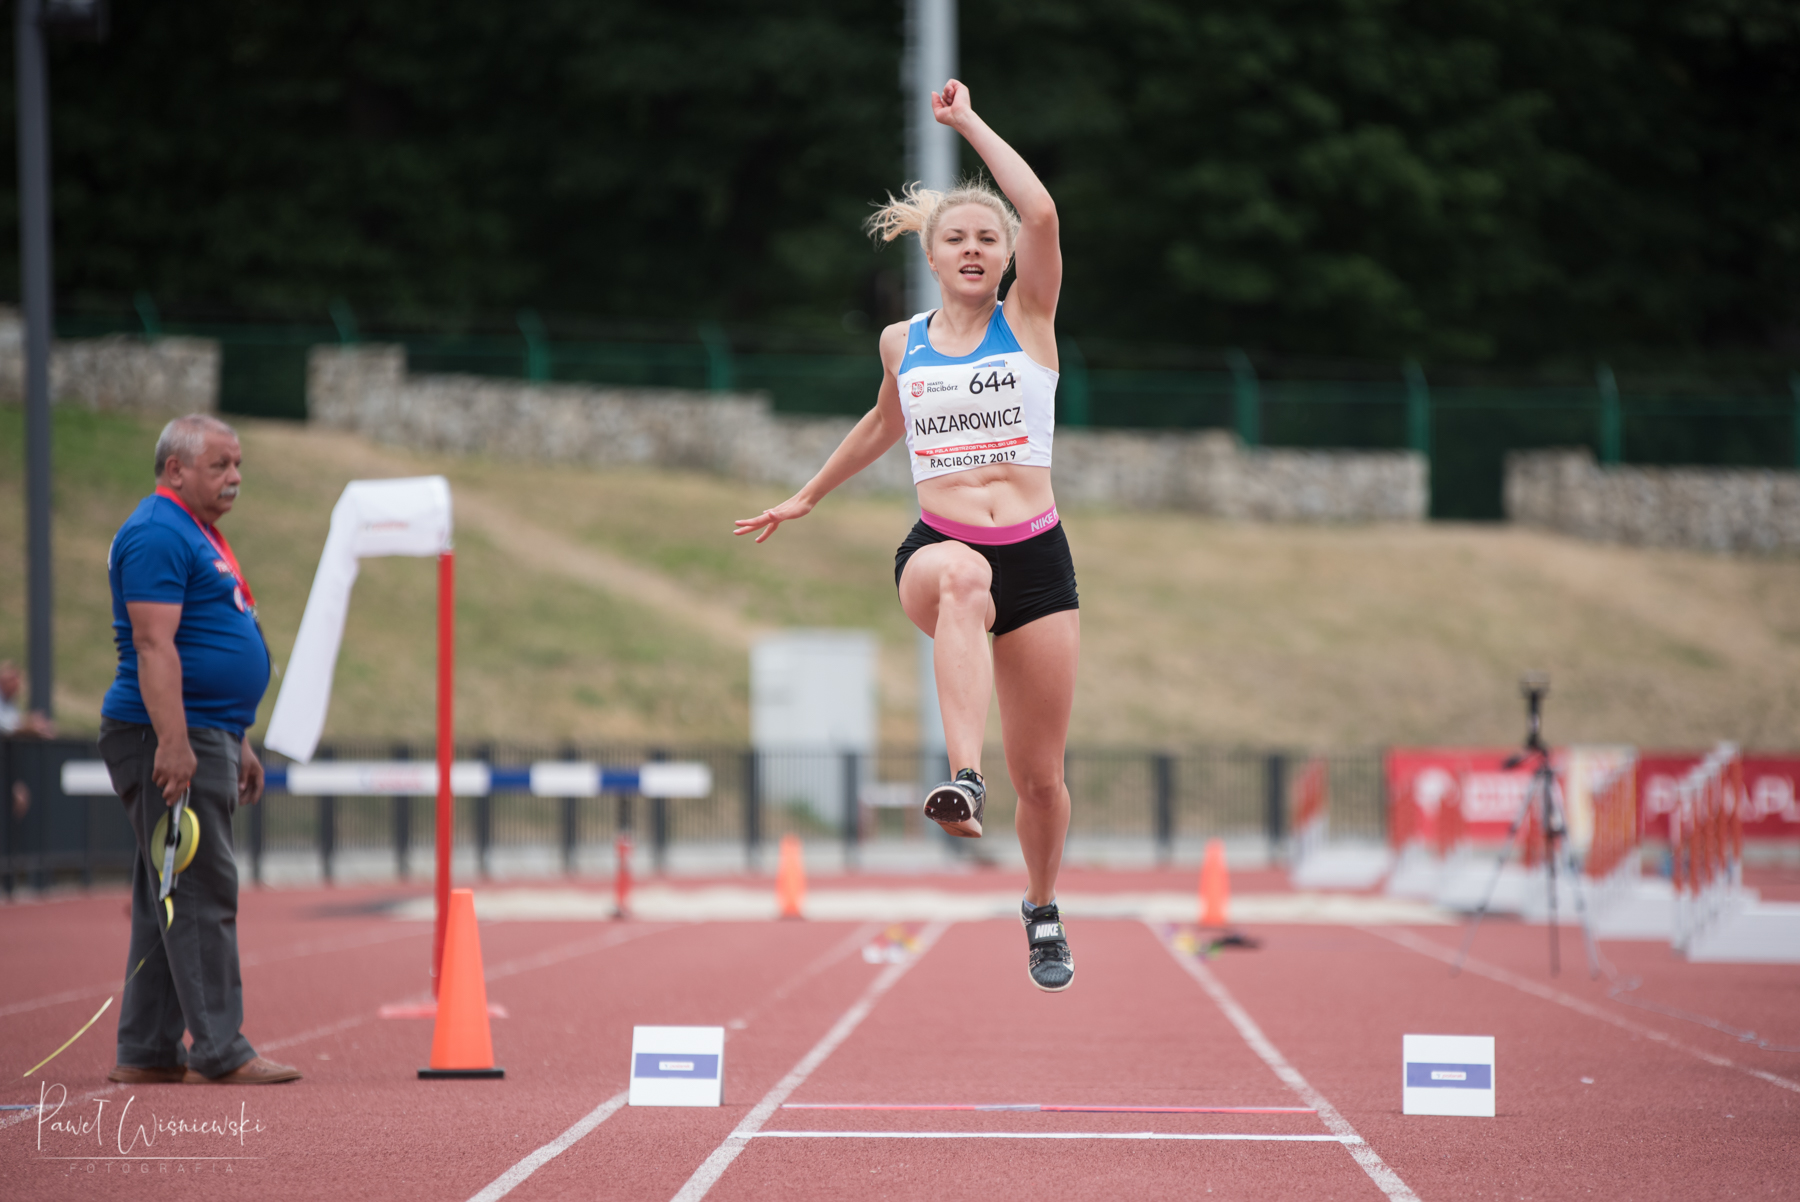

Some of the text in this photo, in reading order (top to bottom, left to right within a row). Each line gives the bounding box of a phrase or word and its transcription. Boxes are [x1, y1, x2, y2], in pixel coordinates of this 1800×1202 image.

[927, 384, 958, 393] Racibórz
[969, 371, 1017, 394] 644
[915, 406, 1022, 436] NAZAROWICZ
[949, 444, 987, 452] MISTRZOSTWA
[930, 450, 1016, 468] RACIBÓRZ 2019
[1030, 512, 1054, 532] NIKE
[1034, 923, 1059, 939] NIKE
